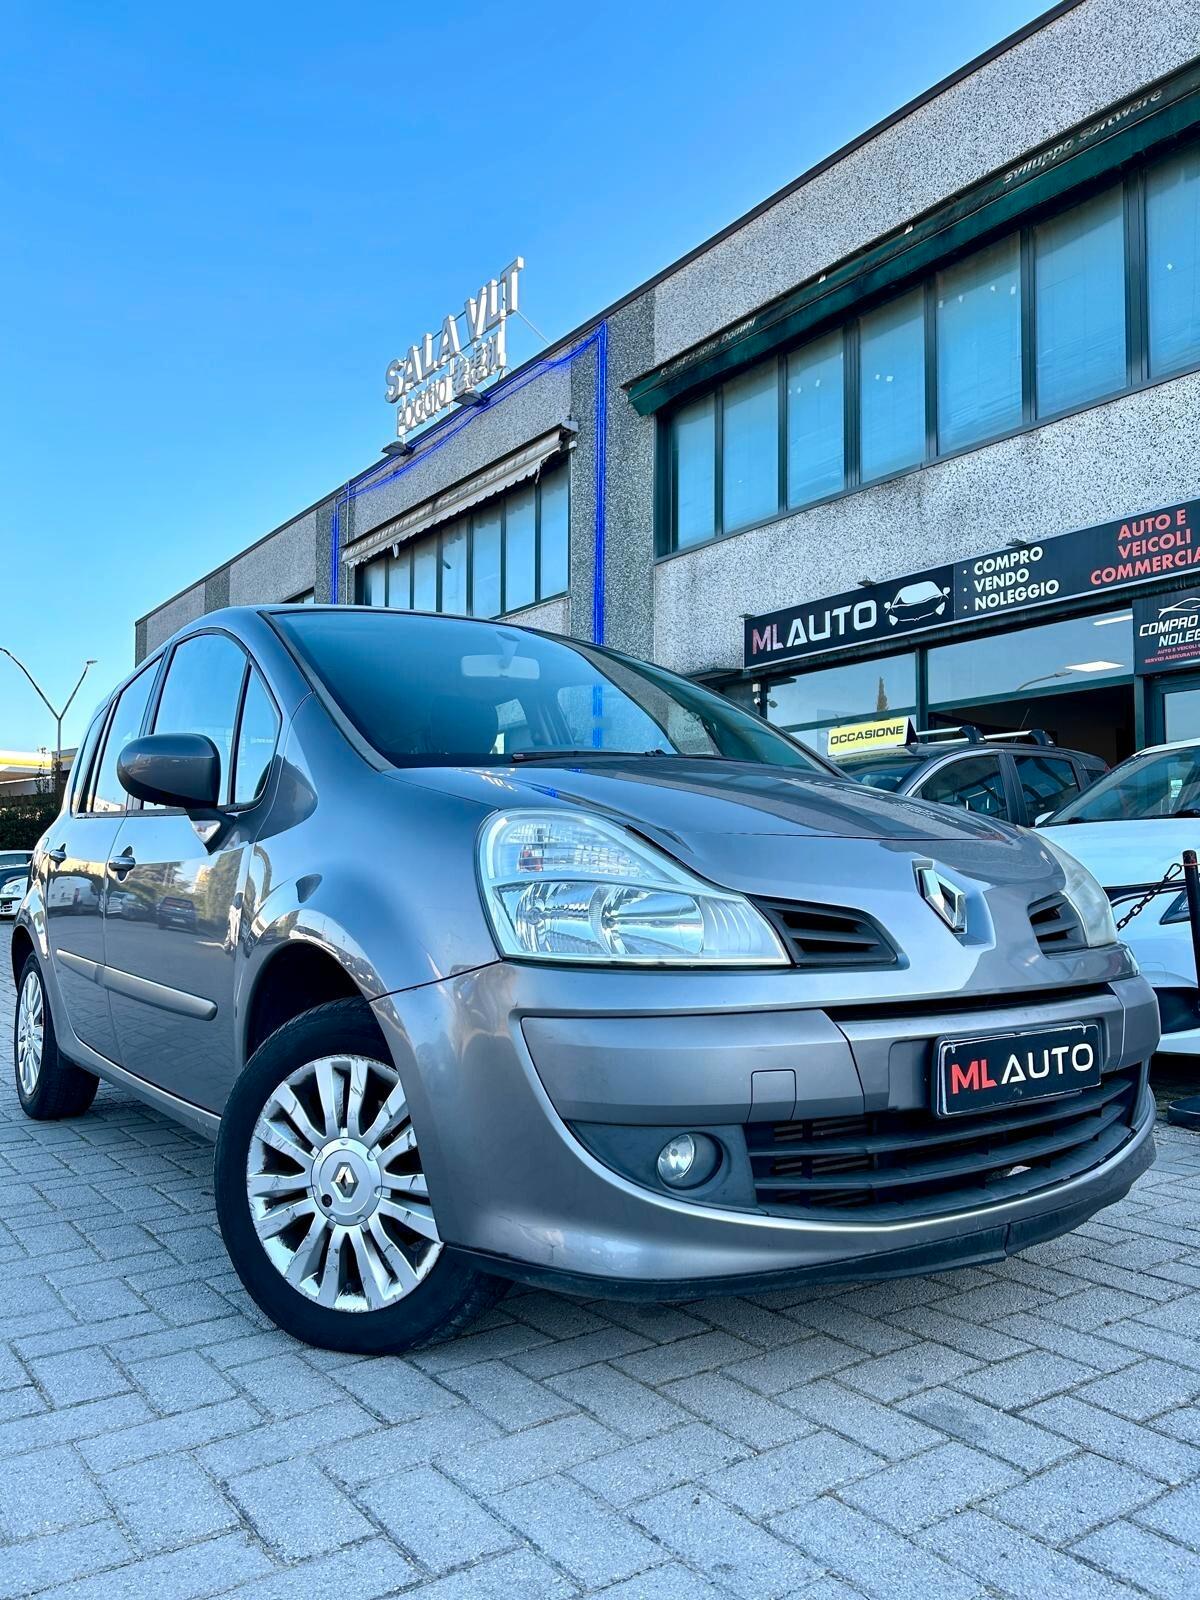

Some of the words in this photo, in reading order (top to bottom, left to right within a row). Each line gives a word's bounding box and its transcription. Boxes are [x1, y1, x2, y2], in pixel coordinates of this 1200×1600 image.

[1003, 139, 1073, 184] Sviluppo
[384, 314, 461, 404] SALA
[464, 256, 525, 343] VLT
[1118, 514, 1171, 540] AUTO
[1176, 509, 1186, 526] E
[1118, 528, 1191, 559] VEICOLI
[973, 546, 1043, 576] COMPRO
[973, 568, 1030, 593] VENDO
[974, 579, 1060, 611] NOLEGGIO
[752, 623, 784, 655] ML
[786, 599, 877, 648] AUTO
[1139, 614, 1199, 637] COMPRO
[1176, 644, 1197, 652] VEICOLI
[830, 725, 904, 745] OCCASIONE
[951, 1059, 998, 1095] ML
[1001, 1043, 1094, 1085] AUTO
